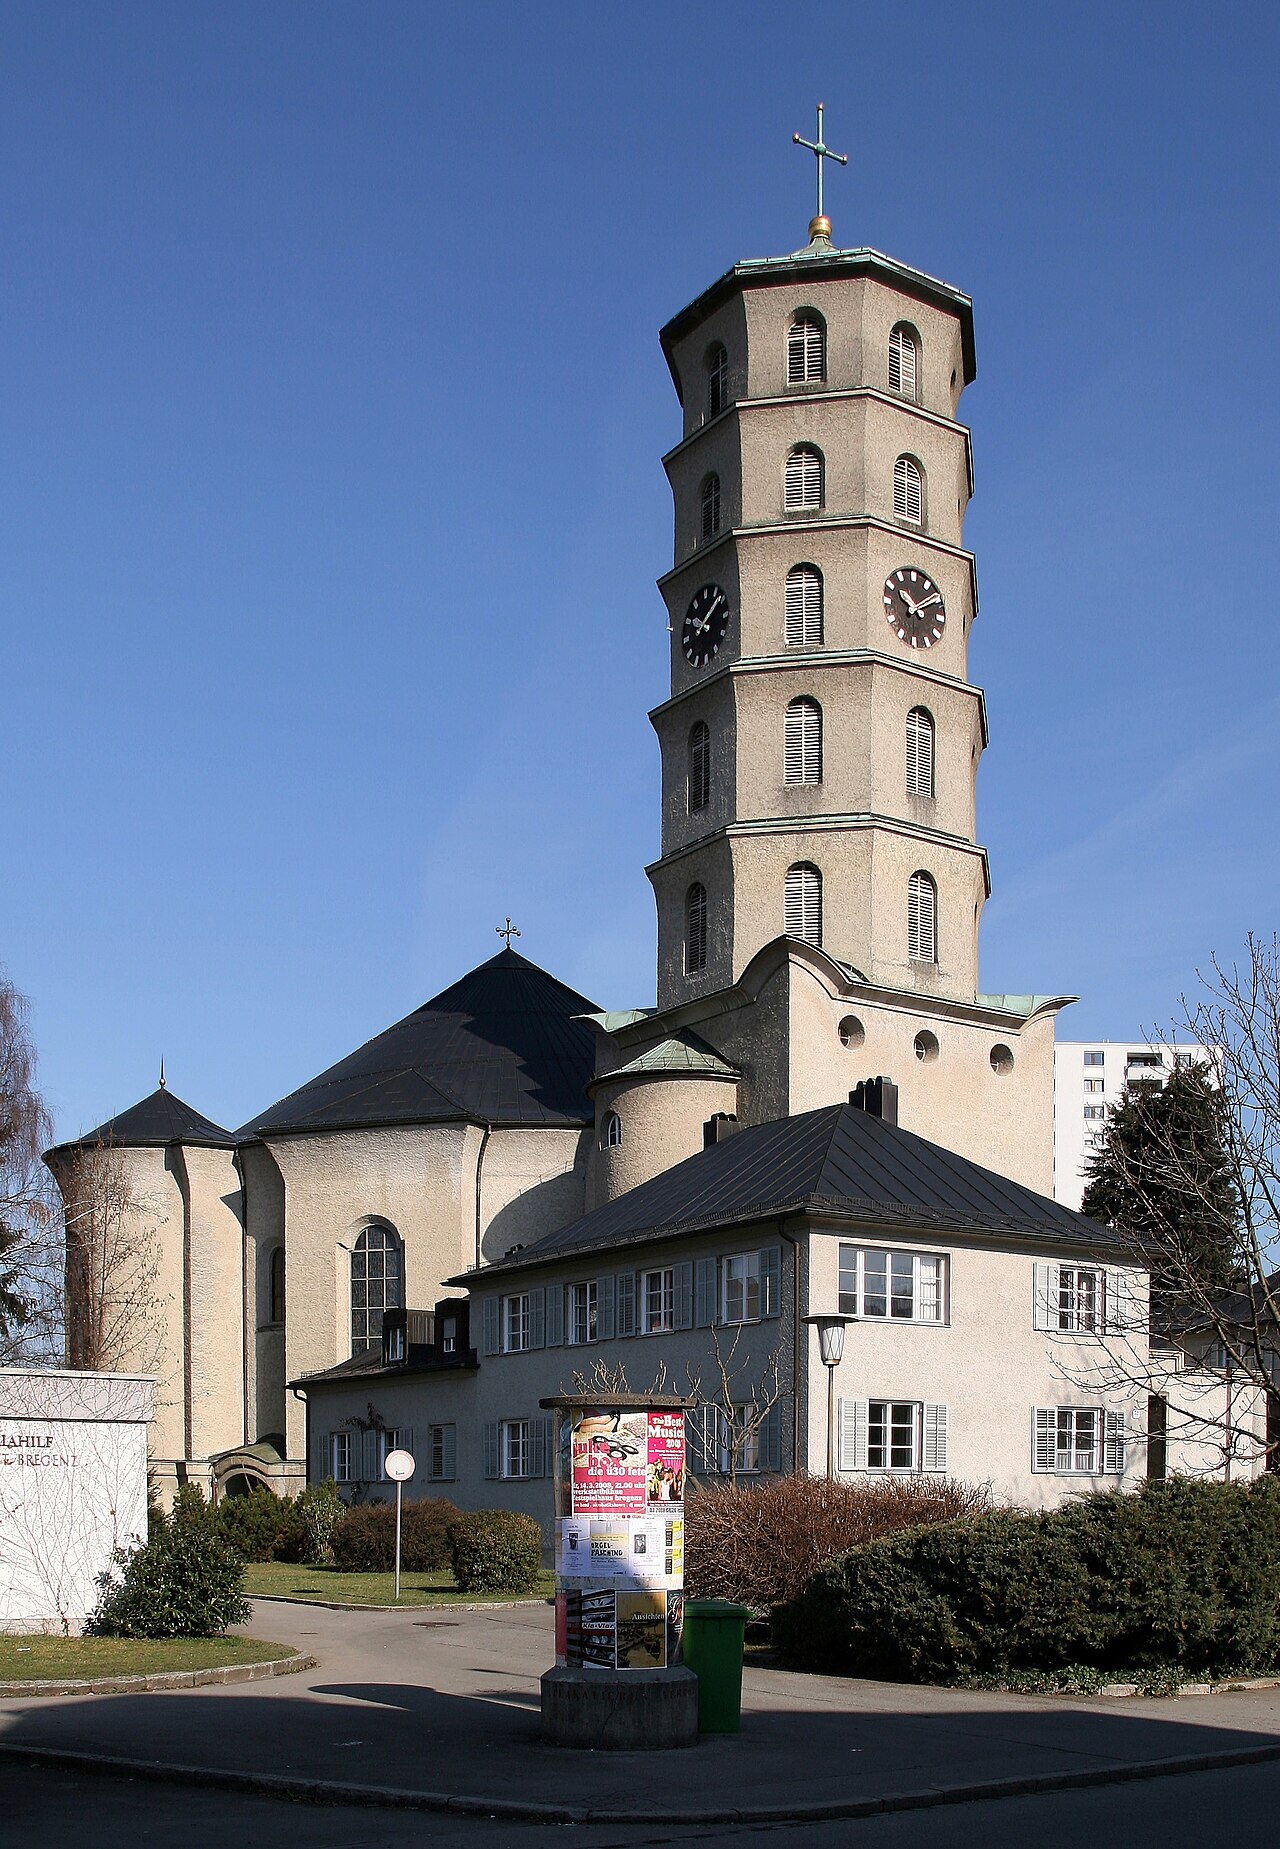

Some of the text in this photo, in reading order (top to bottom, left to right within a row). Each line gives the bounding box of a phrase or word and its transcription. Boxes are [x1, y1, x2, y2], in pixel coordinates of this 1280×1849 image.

[664, 1415, 683, 1427] Best
[0, 1435, 53, 1448] IAHILF
[18, 1454, 78, 1467] BREGENZ
[588, 1454, 621, 1469] box
[588, 1467, 646, 1476] die ü30 fete
[632, 1613, 665, 1621] Ansichten
